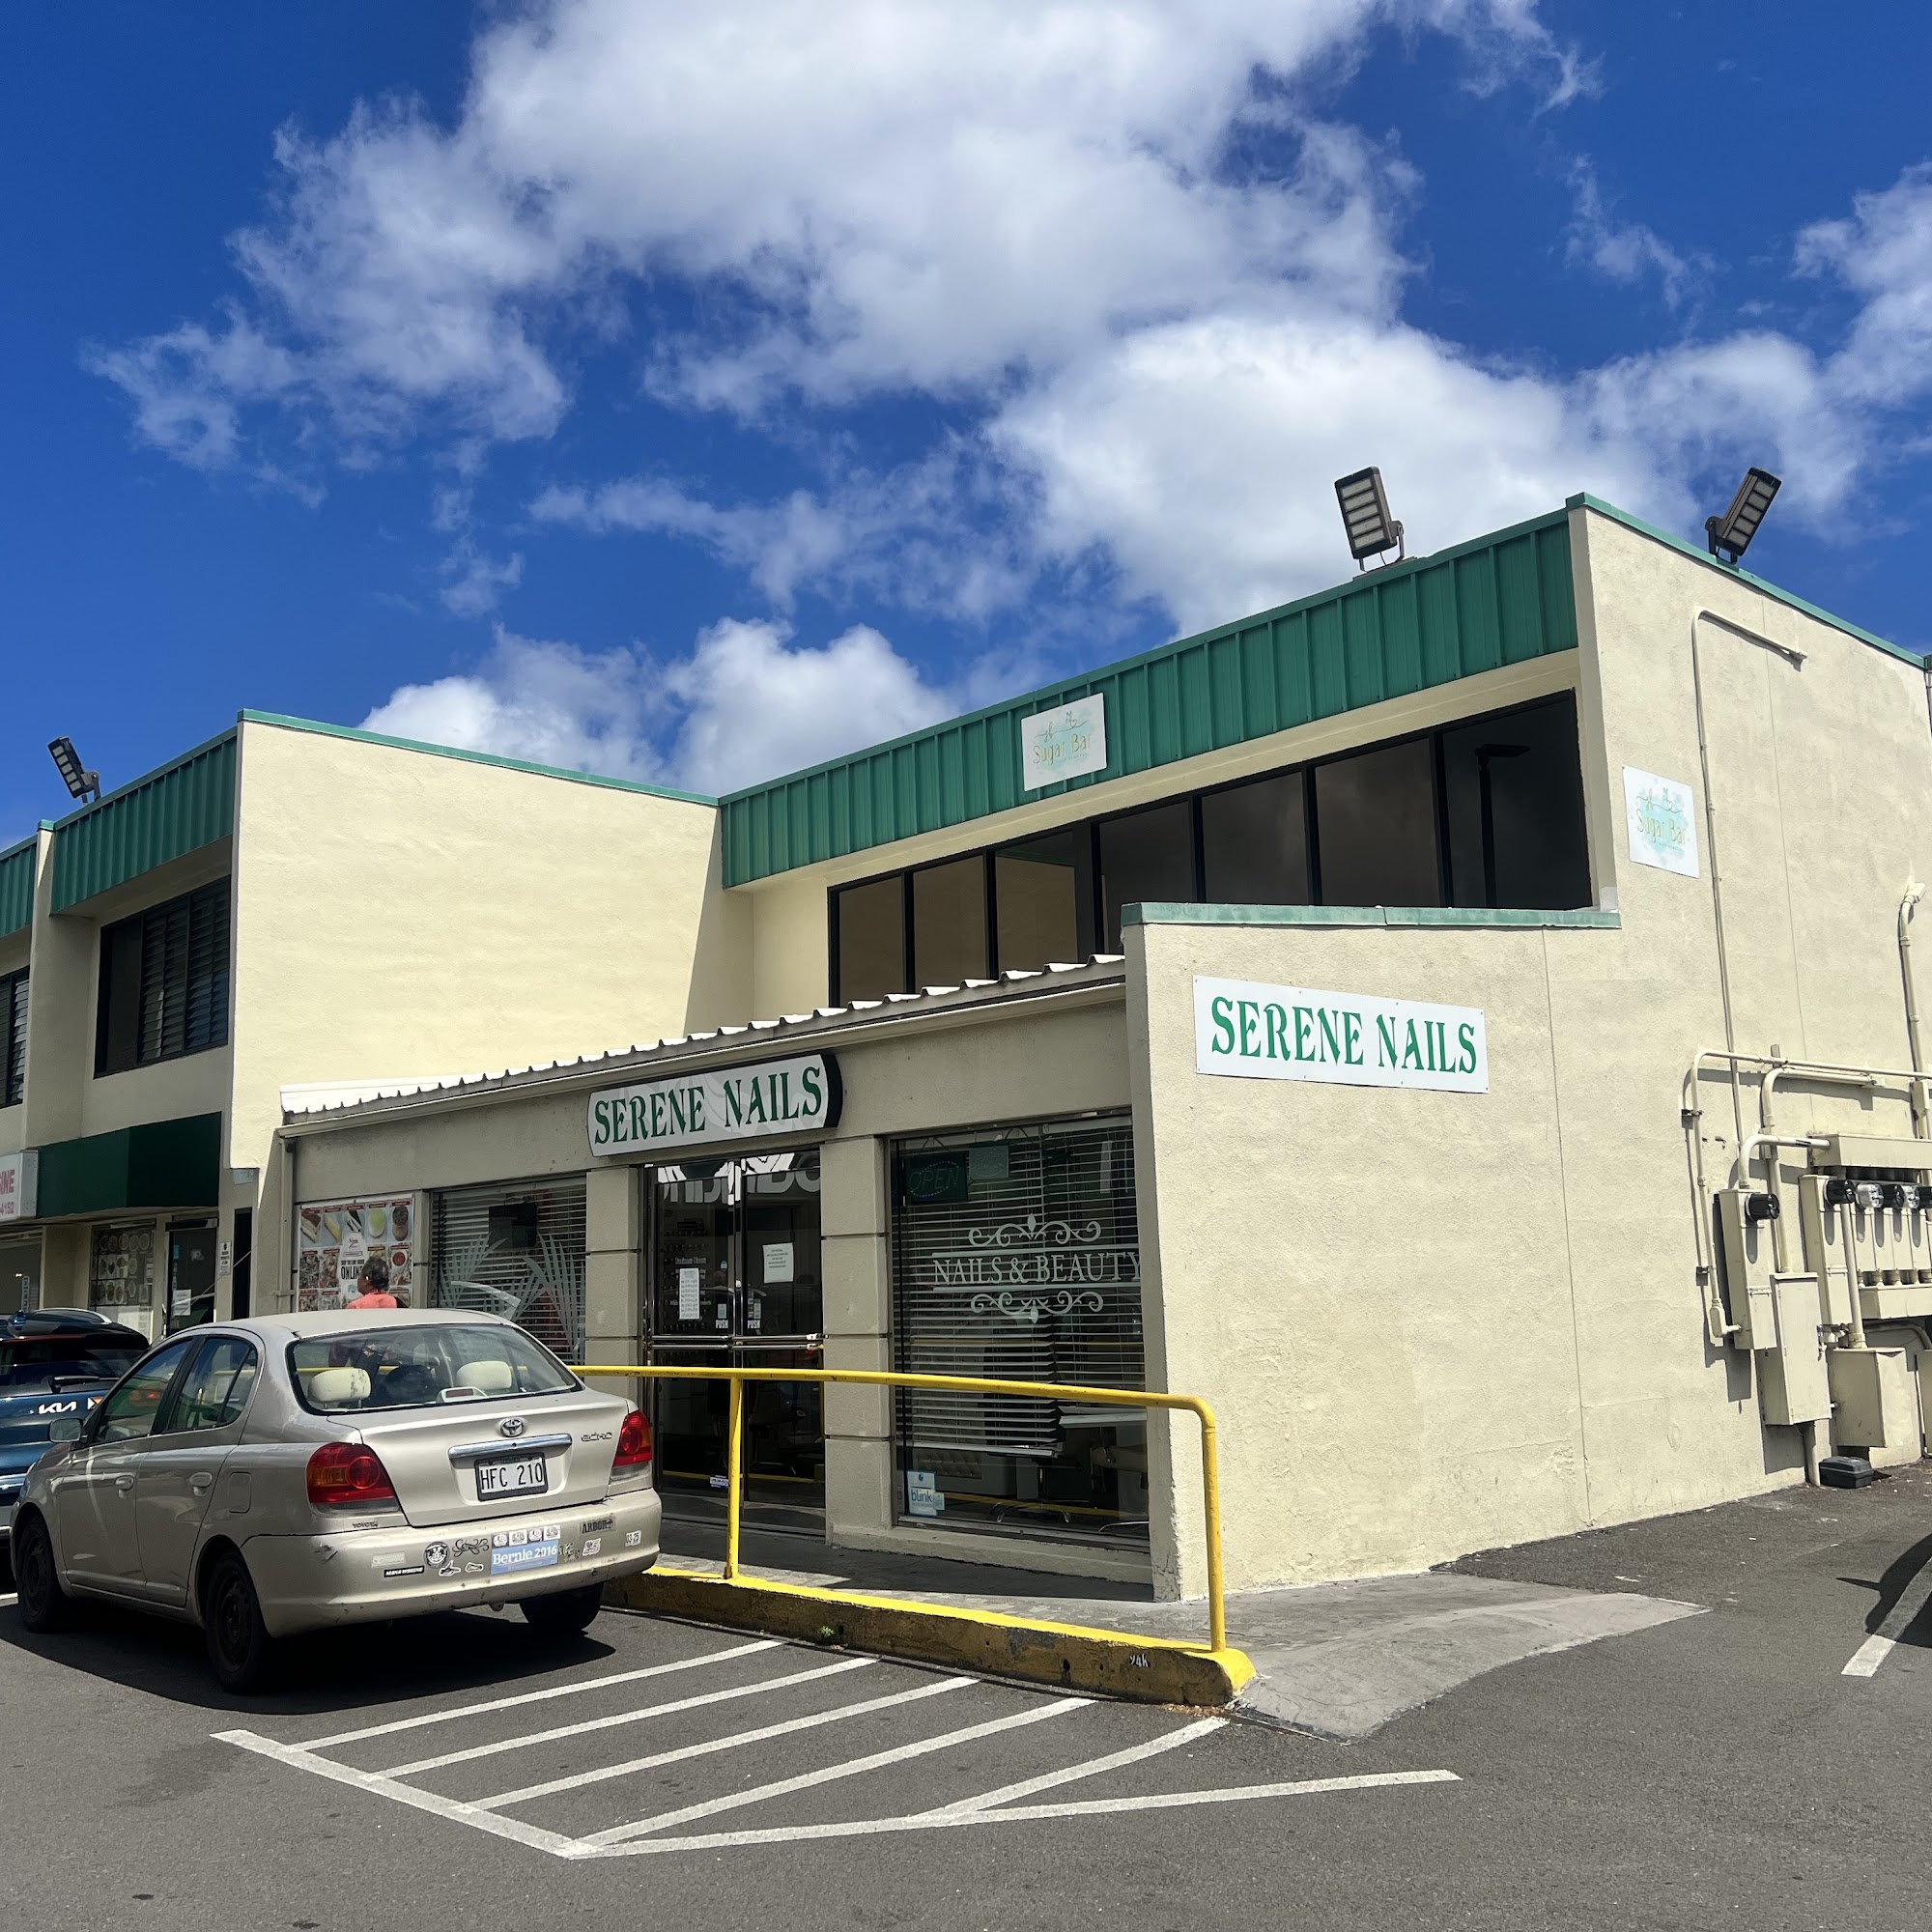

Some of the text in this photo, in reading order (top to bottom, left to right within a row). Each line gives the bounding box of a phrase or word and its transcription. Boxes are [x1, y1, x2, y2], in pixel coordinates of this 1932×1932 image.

[1033, 741, 1065, 766] Sugar
[1071, 733, 1092, 753] Bar
[1211, 996, 1477, 1073] SERENE NAILS
[594, 1066, 822, 1145] SERENE NAILS
[909, 1166, 959, 1191] OPEN
[933, 1251, 1142, 1285] NAILS & BEAUTY
[716, 1320, 728, 1328] PUSH
[748, 1320, 761, 1329] PUSH
[39, 1401, 76, 1414] KIA
[480, 1462, 543, 1491] HFC 210
[582, 1519, 608, 1534] ARBOR
[493, 1545, 557, 1565] Bernie 2016
